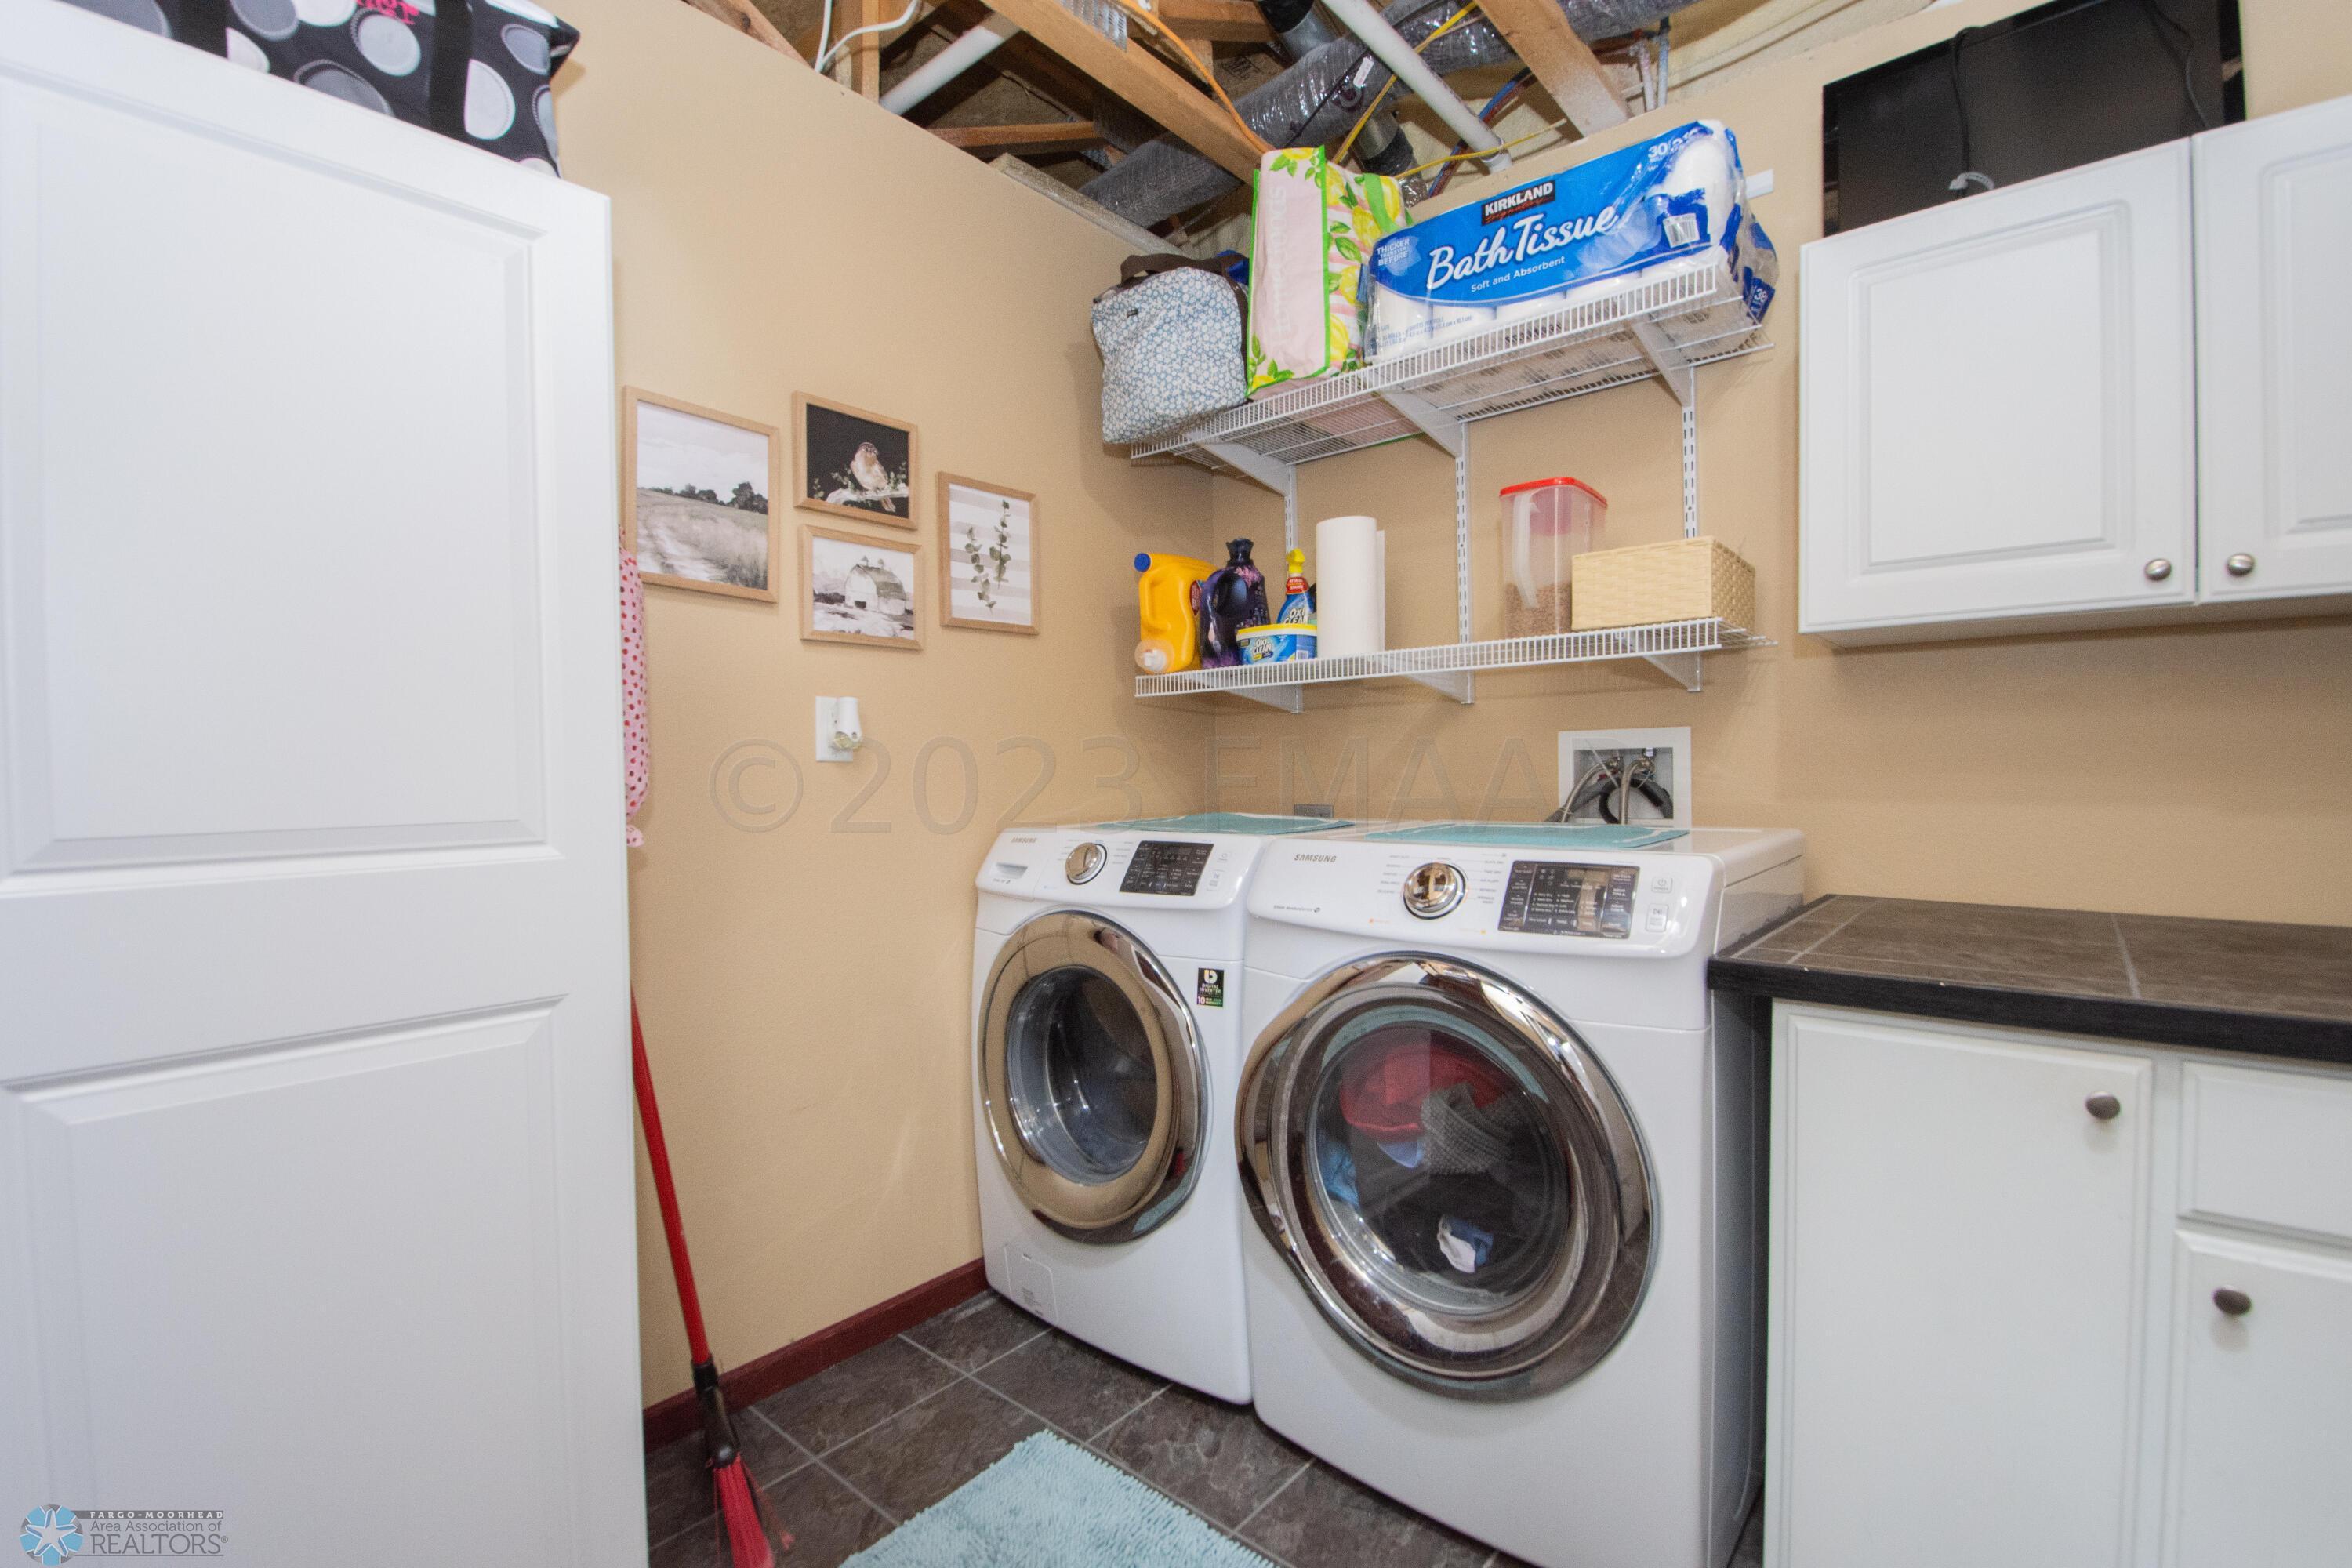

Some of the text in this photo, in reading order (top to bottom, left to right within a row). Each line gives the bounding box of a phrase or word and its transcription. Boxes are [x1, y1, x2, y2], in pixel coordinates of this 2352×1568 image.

[1485, 182, 1553, 216] KIRKLAND
[1377, 238, 1410, 255] THICKER
[1427, 227, 1514, 289] Bath
[1513, 206, 1619, 261] Tissue
[1378, 251, 1408, 266] BEFORE
[1471, 256, 1566, 292] Soft and Absorbent
[1289, 608, 1305, 619] OXI
[1254, 644, 1272, 655] CLEAN
[1294, 853, 1338, 863] SAMSUNG
[1197, 996, 1206, 1005] 10
